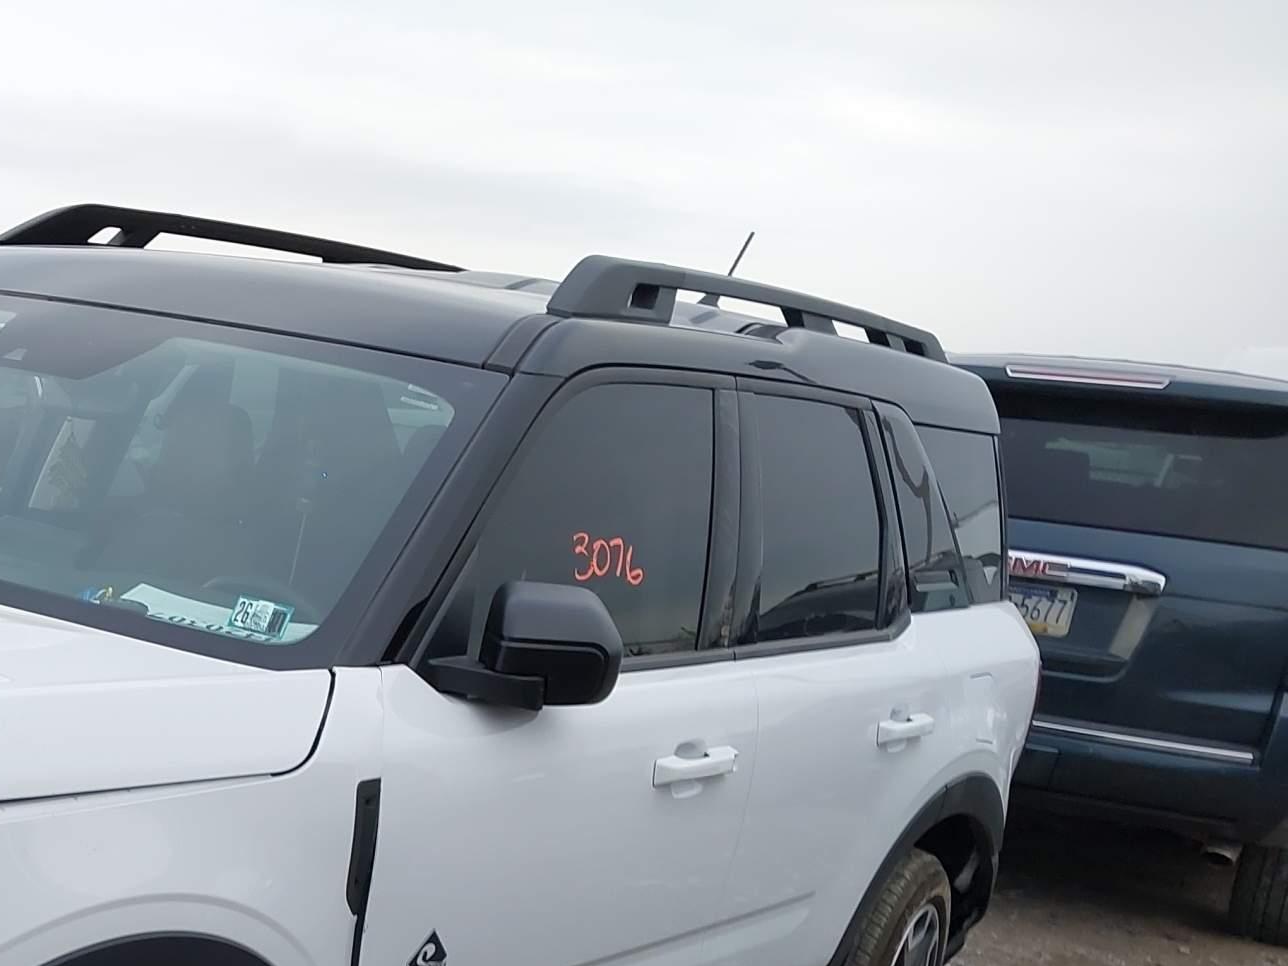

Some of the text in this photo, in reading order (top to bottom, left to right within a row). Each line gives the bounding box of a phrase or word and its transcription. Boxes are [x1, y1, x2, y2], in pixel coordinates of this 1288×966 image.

[573, 532, 644, 585] 3076
[1008, 556, 1068, 577] MC
[233, 600, 253, 624] 26
[1009, 595, 1067, 625] 5677
